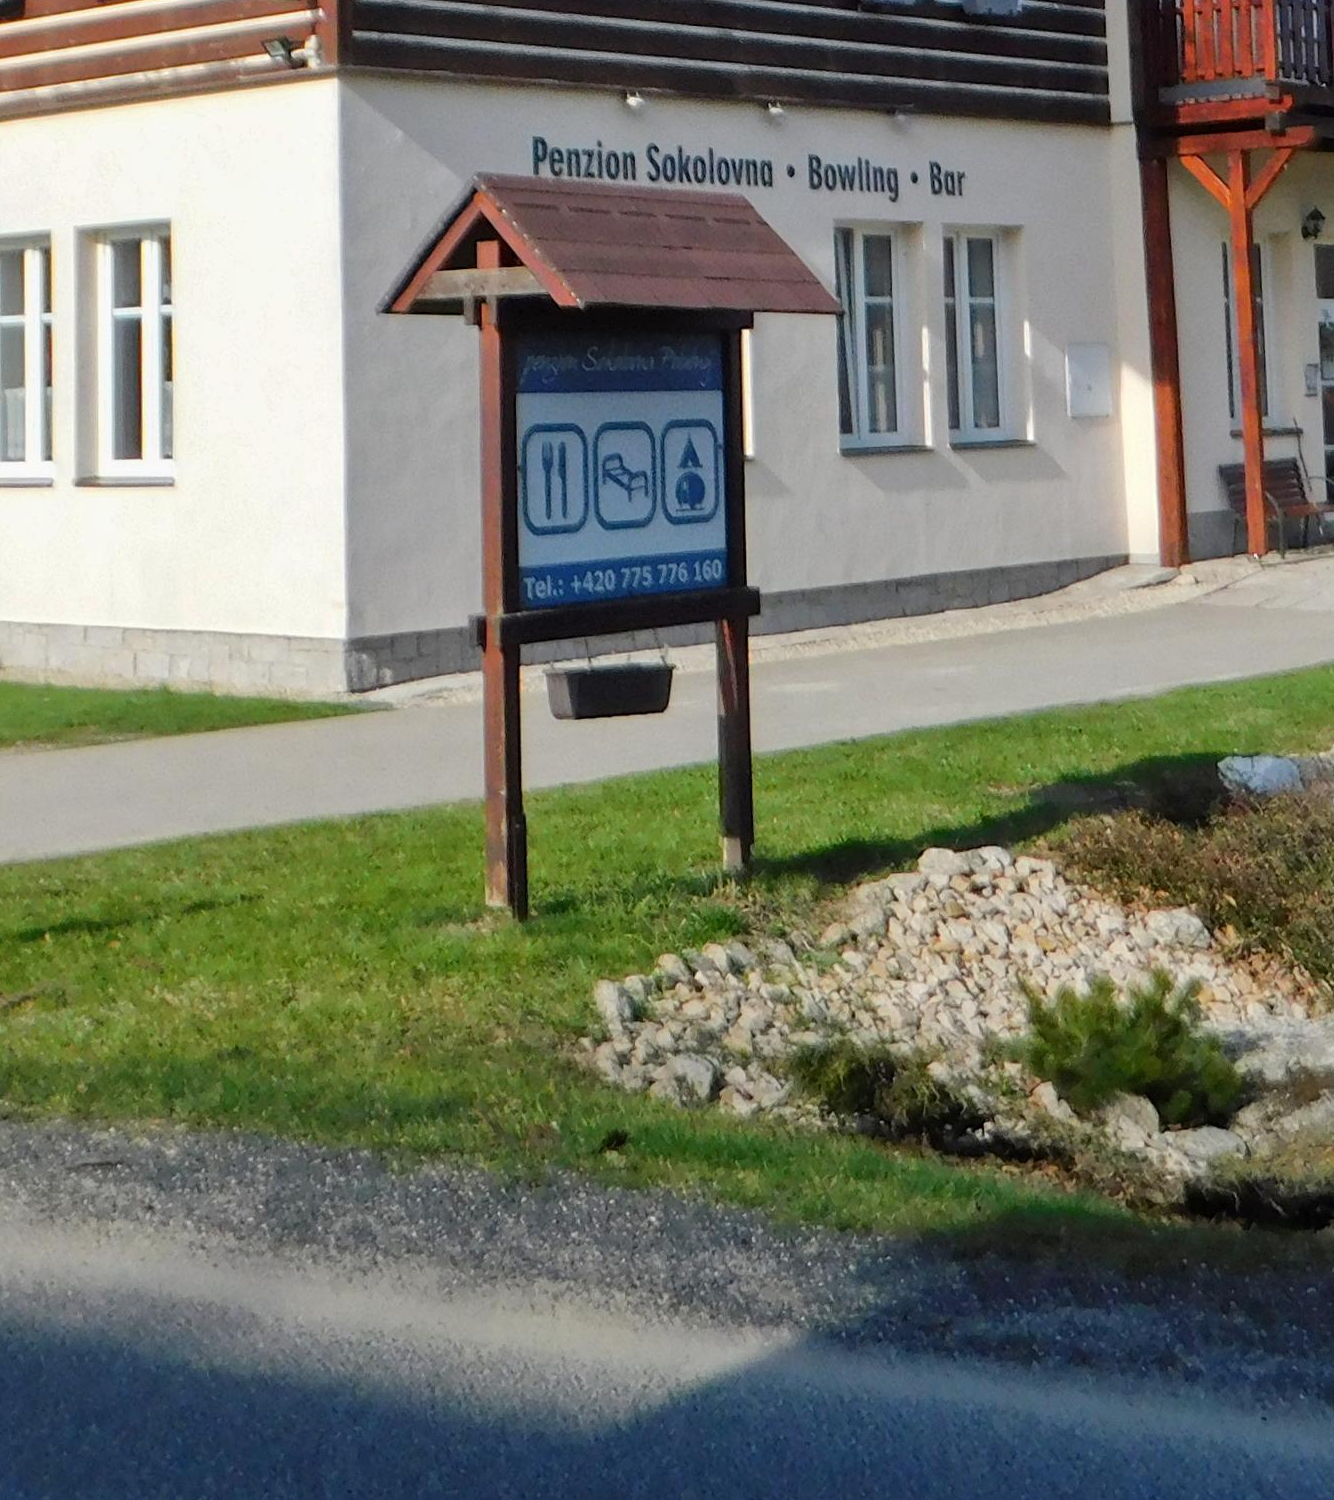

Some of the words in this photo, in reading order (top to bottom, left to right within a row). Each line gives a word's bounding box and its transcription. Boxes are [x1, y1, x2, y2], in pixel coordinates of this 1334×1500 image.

[532, 136, 636, 181] Penzion
[646, 142, 773, 187] Sokolovna
[808, 154, 899, 202] Bowling
[929, 160, 965, 196] Bar
[523, 575, 564, 600] Tel.:
[570, 569, 616, 595] +420
[620, 566, 652, 589] 775
[657, 562, 688, 584] 776
[694, 559, 722, 582] 160
